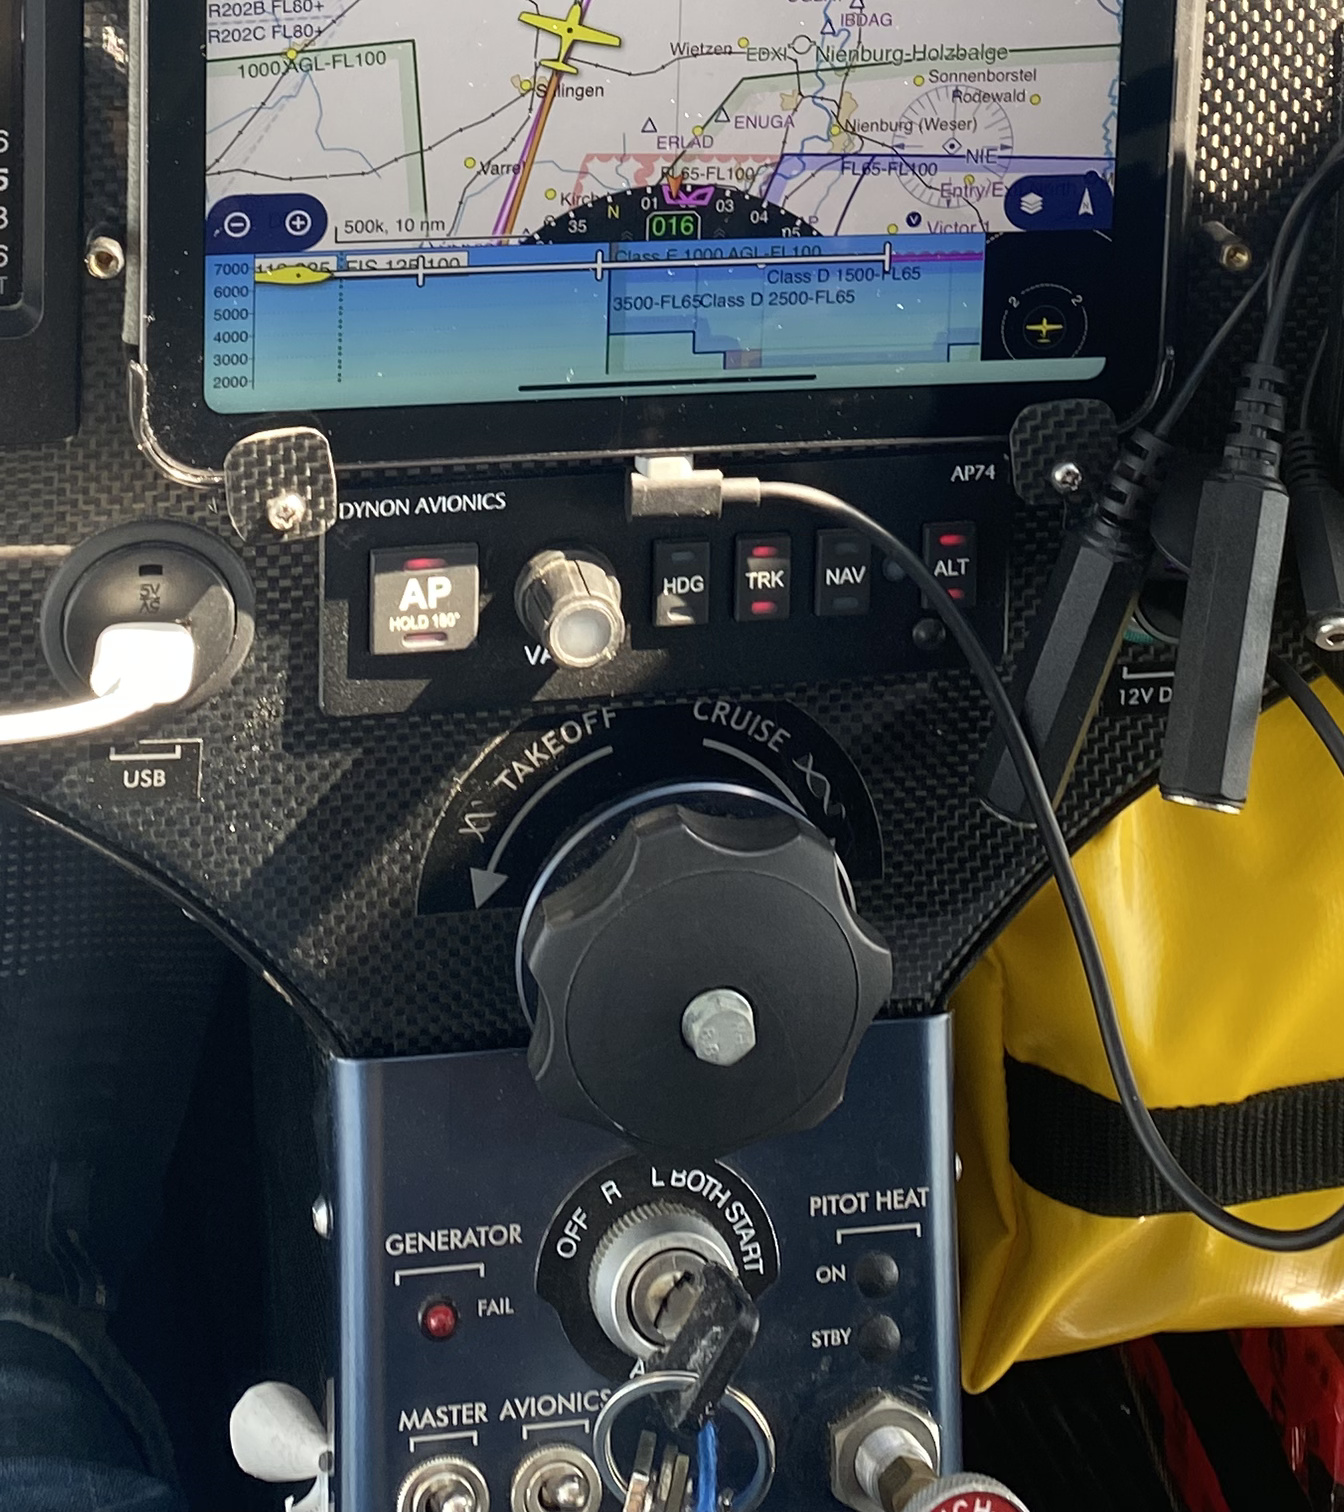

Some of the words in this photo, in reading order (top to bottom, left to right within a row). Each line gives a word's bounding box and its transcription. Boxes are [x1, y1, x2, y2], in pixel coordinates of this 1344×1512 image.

[816, 45, 1008, 63] Nienburg-Holzbalge
[929, 69, 1036, 84] Sonnenborstel
[344, 219, 388, 236] 500k,
[397, 219, 413, 233] 10
[419, 221, 445, 232] nm
[951, 464, 995, 483] AP74
[339, 498, 409, 521] DYNON
[416, 493, 506, 515] AVIONICS
[826, 566, 866, 586] NAV
[934, 558, 969, 577] ALT
[663, 575, 704, 594] HDG
[746, 570, 784, 589] TRK
[400, 579, 451, 610] AP
[389, 615, 427, 631] HOLD
[693, 700, 791, 753] CRUISE
[494, 707, 617, 792] TAKEOFF
[123, 769, 166, 788] USB
[671, 1169, 731, 1209] BOTH
[810, 1192, 867, 1217] PITOT
[876, 1187, 929, 1211] HEAT
[385, 1224, 523, 1256] GENERATOR
[556, 1210, 588, 1259] OFF
[724, 1202, 764, 1275] START
[816, 1264, 846, 1283] ON
[478, 1297, 514, 1317] FAIL
[812, 1328, 852, 1348] STBY
[399, 1403, 488, 1431] MASTER
